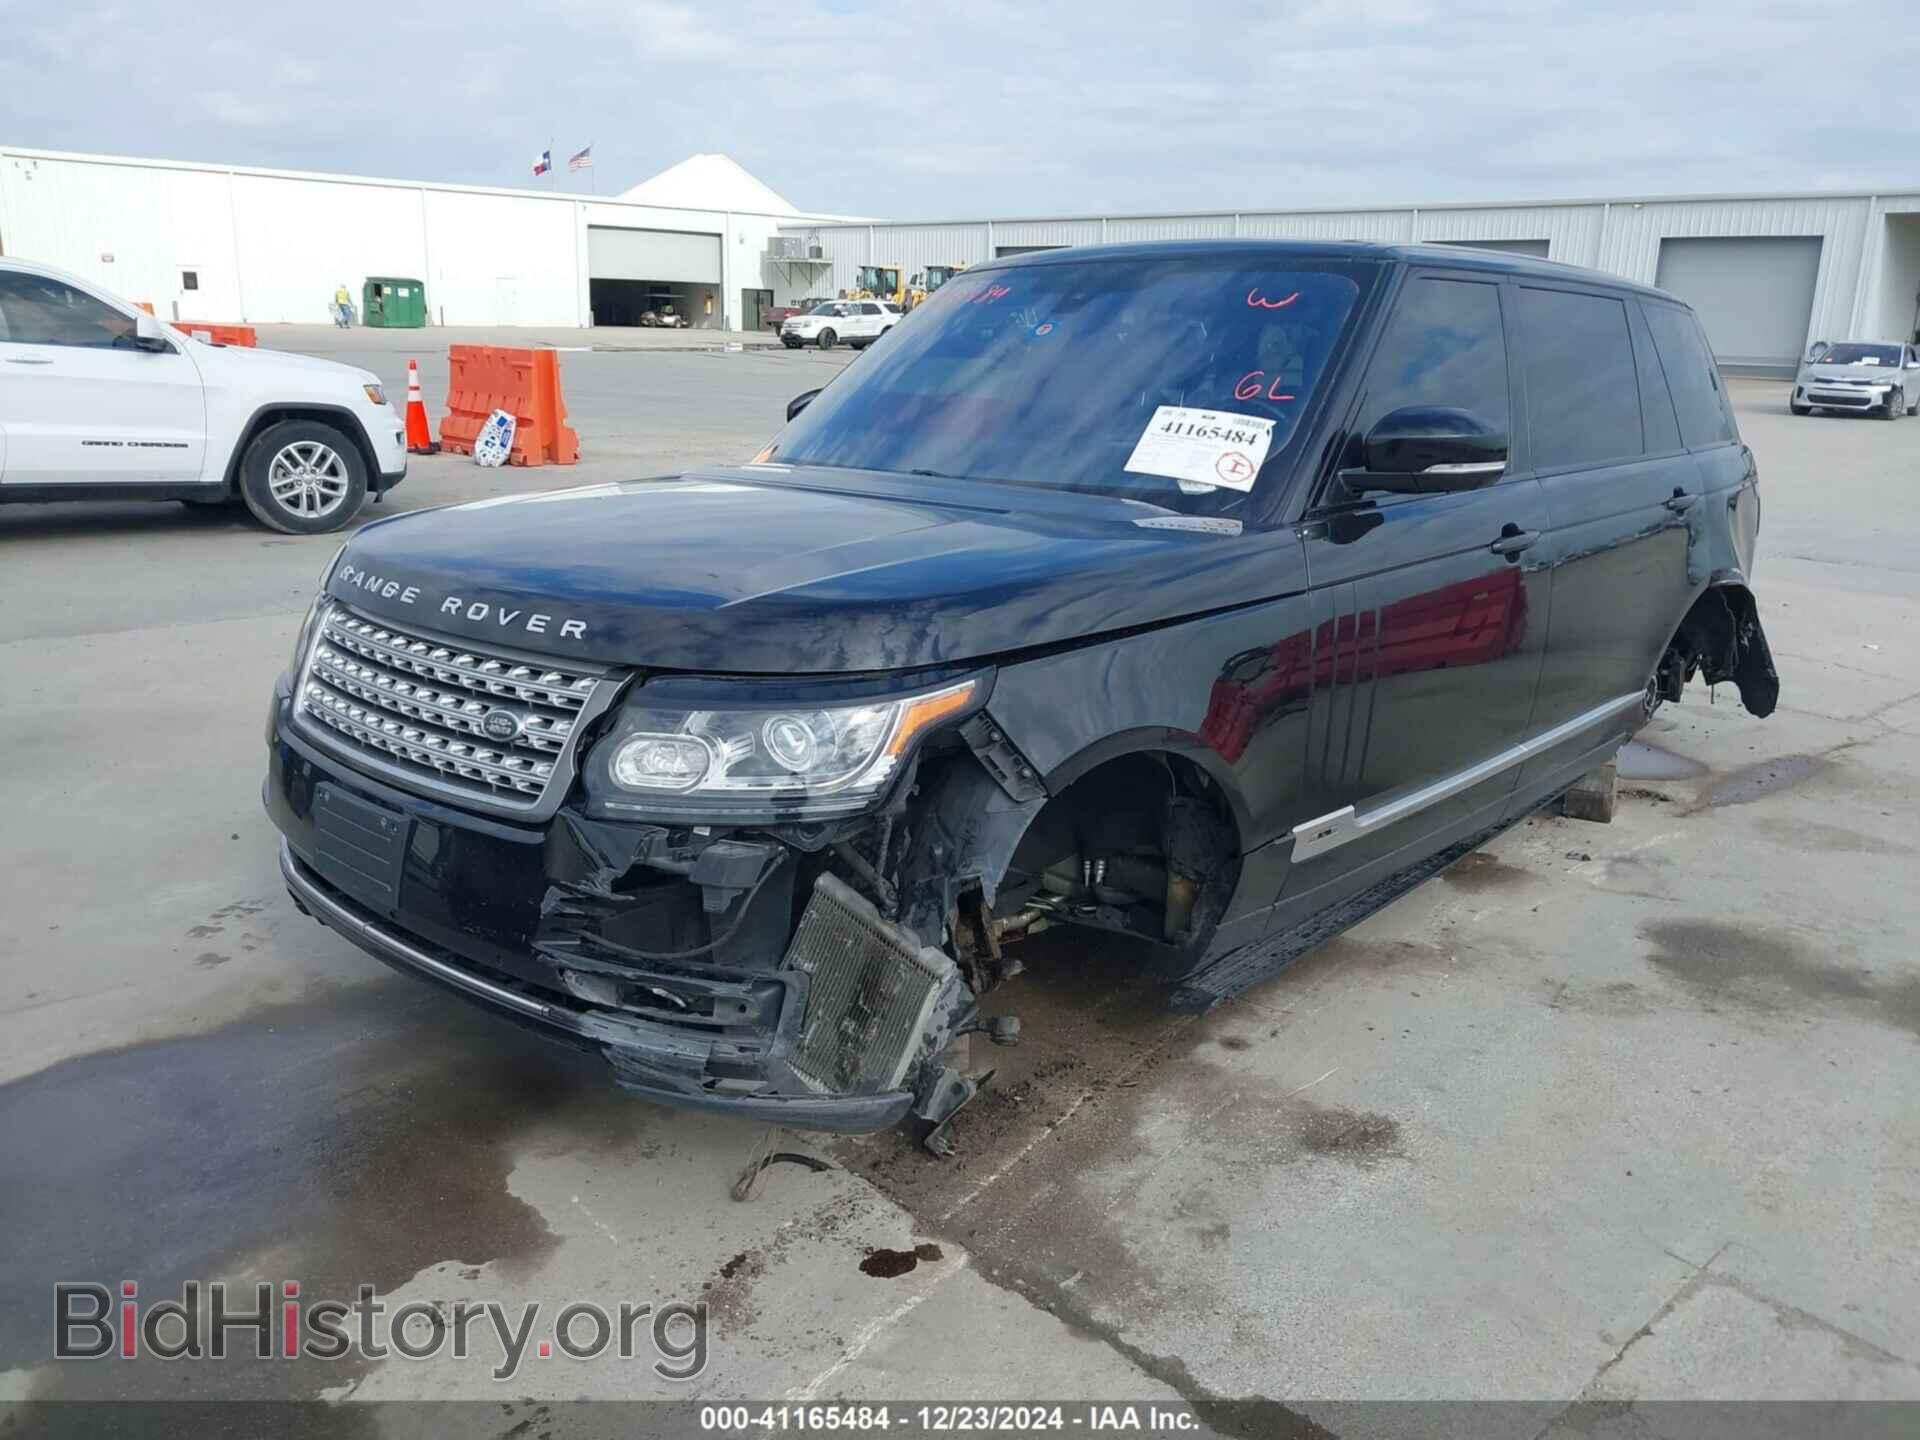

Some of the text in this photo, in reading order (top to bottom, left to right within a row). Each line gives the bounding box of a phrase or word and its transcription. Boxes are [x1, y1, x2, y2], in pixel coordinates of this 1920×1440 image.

[1160, 421, 1257, 446] 41165484
[339, 565, 587, 640] RANGE ROVER
